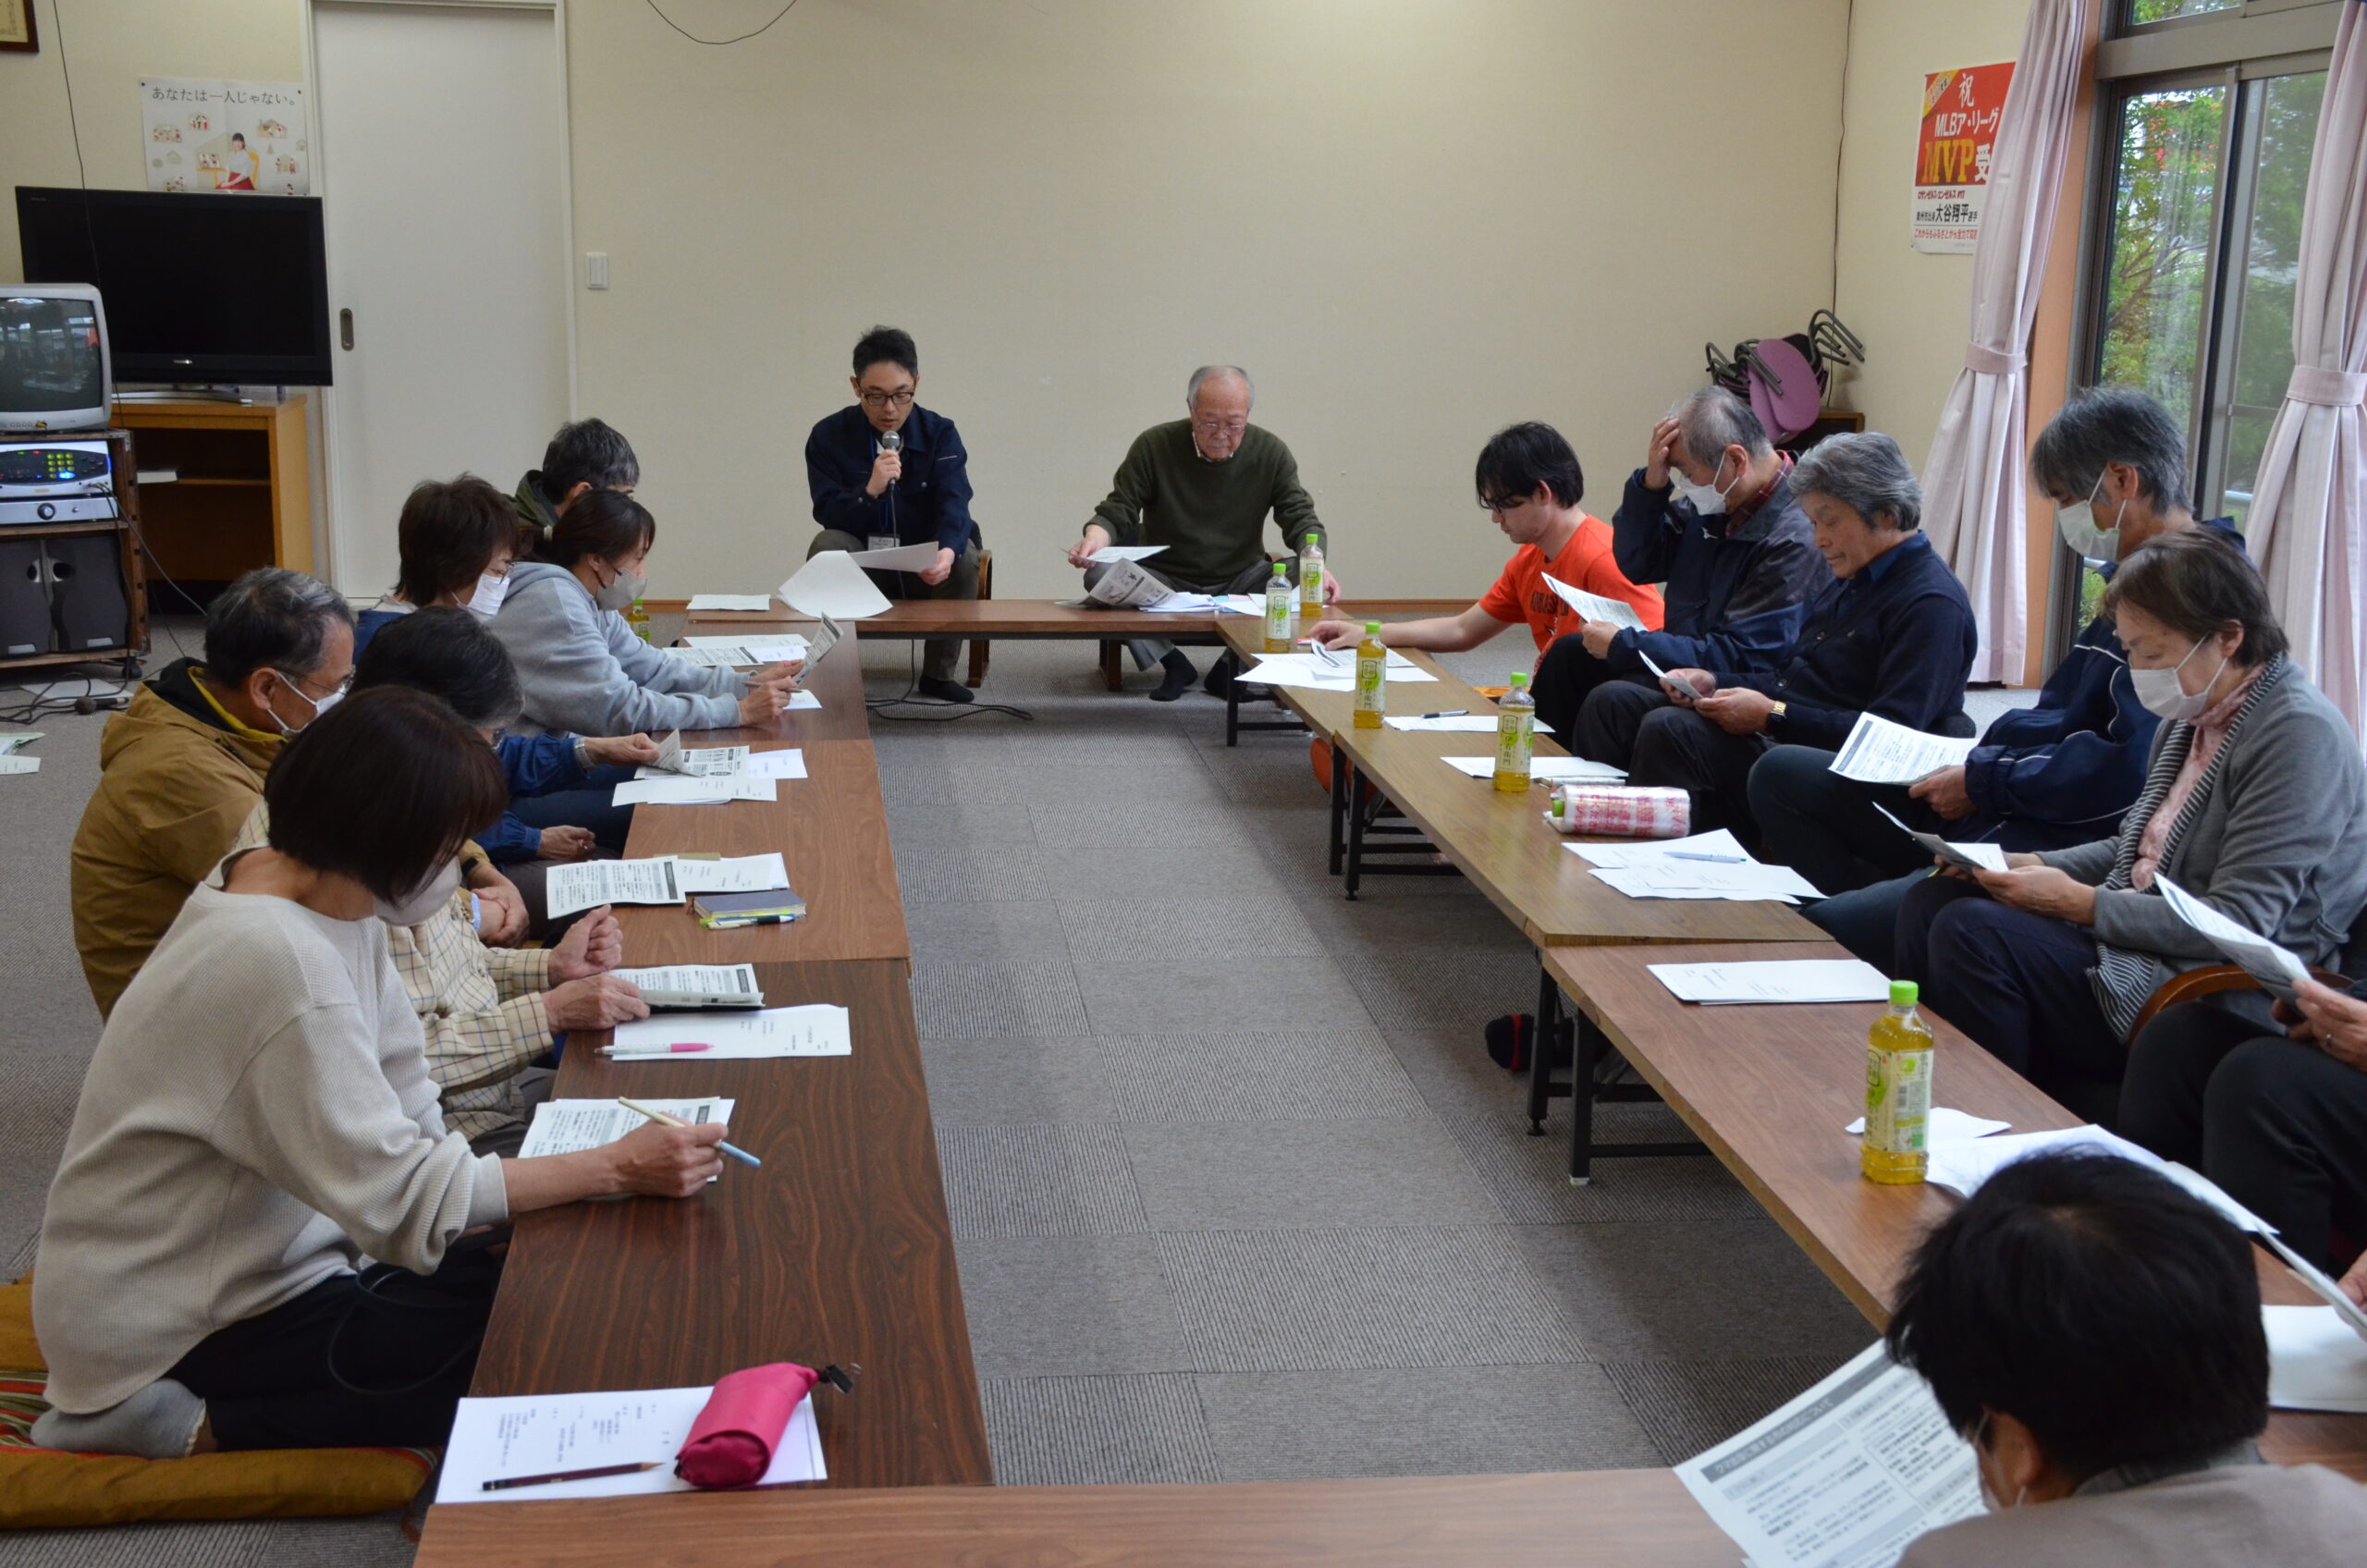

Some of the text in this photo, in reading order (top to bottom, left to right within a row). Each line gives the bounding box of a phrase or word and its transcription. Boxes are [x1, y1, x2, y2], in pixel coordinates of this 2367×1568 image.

[152, 87, 296, 105] あなたは一人じゃない。
[1958, 73, 1975, 108] 祝
[1934, 107, 2000, 138] MLBア・リーグ
